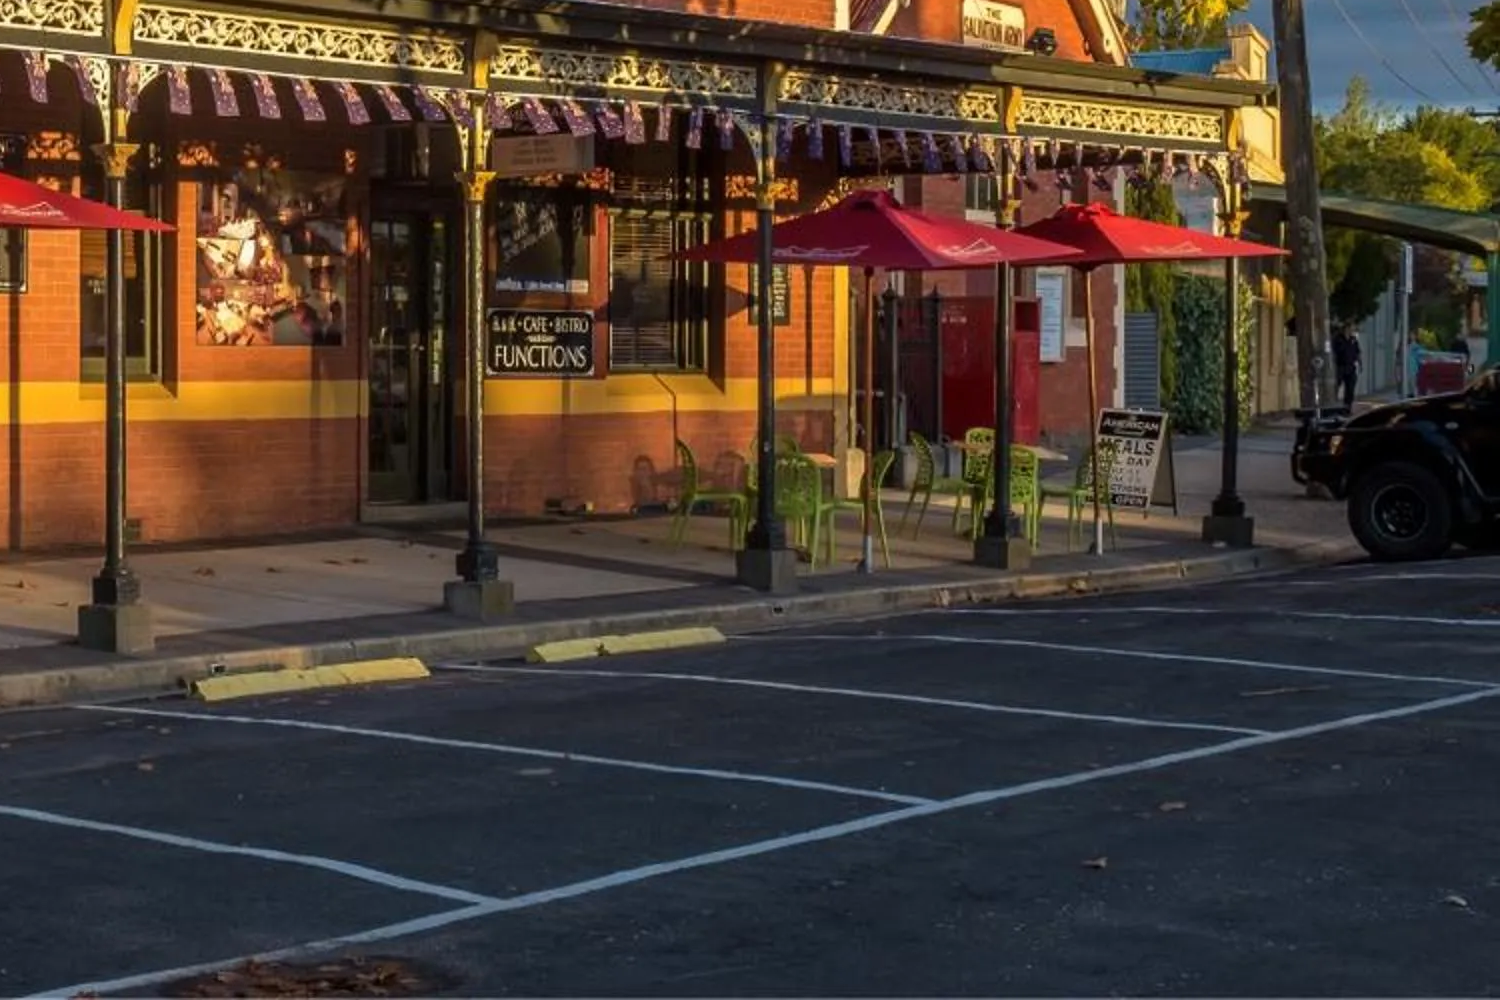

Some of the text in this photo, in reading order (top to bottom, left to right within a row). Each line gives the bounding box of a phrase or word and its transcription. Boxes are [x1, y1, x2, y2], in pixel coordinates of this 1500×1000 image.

[984, 7, 1003, 21] THE
[523, 315, 548, 333] CAFE
[554, 316, 590, 334] BISTRO
[495, 344, 588, 369] FUNCTIONS
[1101, 416, 1160, 431] AMERICAN
